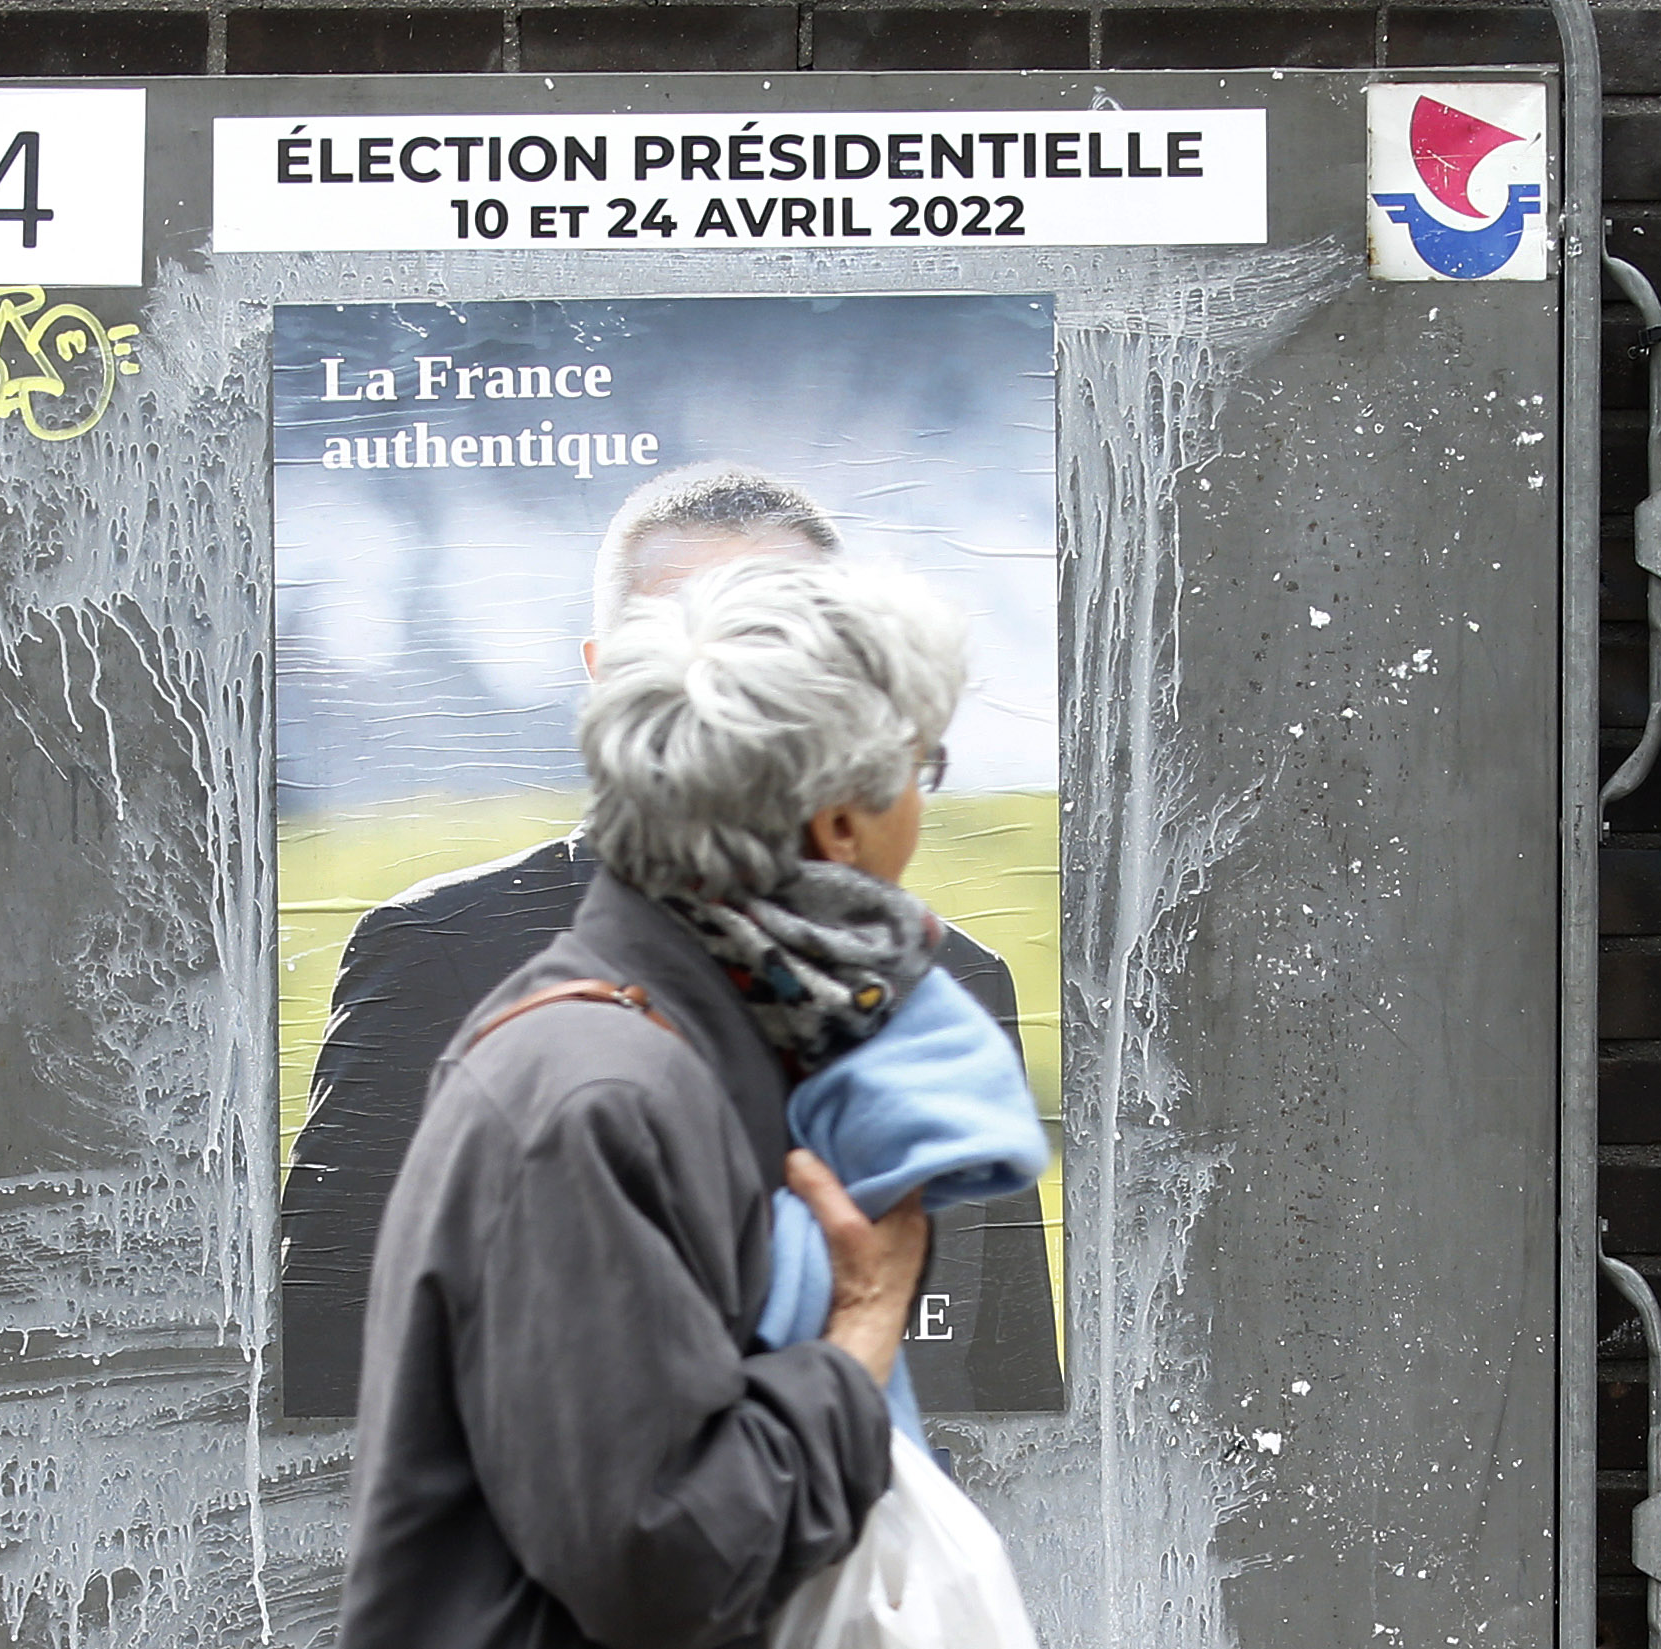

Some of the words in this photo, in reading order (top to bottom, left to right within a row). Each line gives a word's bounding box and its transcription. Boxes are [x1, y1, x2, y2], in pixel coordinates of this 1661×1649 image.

[277, 124, 607, 184] ÉLECTION
[634, 121, 1204, 181] PRÉSIDENTIELLE
[450, 198, 509, 240] 10
[530, 205, 590, 239] ET
[606, 197, 678, 238] 24
[694, 197, 872, 238] AVRIL
[889, 195, 1026, 237] 2022
[320, 357, 396, 402] La
[415, 354, 613, 400] France
[322, 420, 660, 480] authentique
